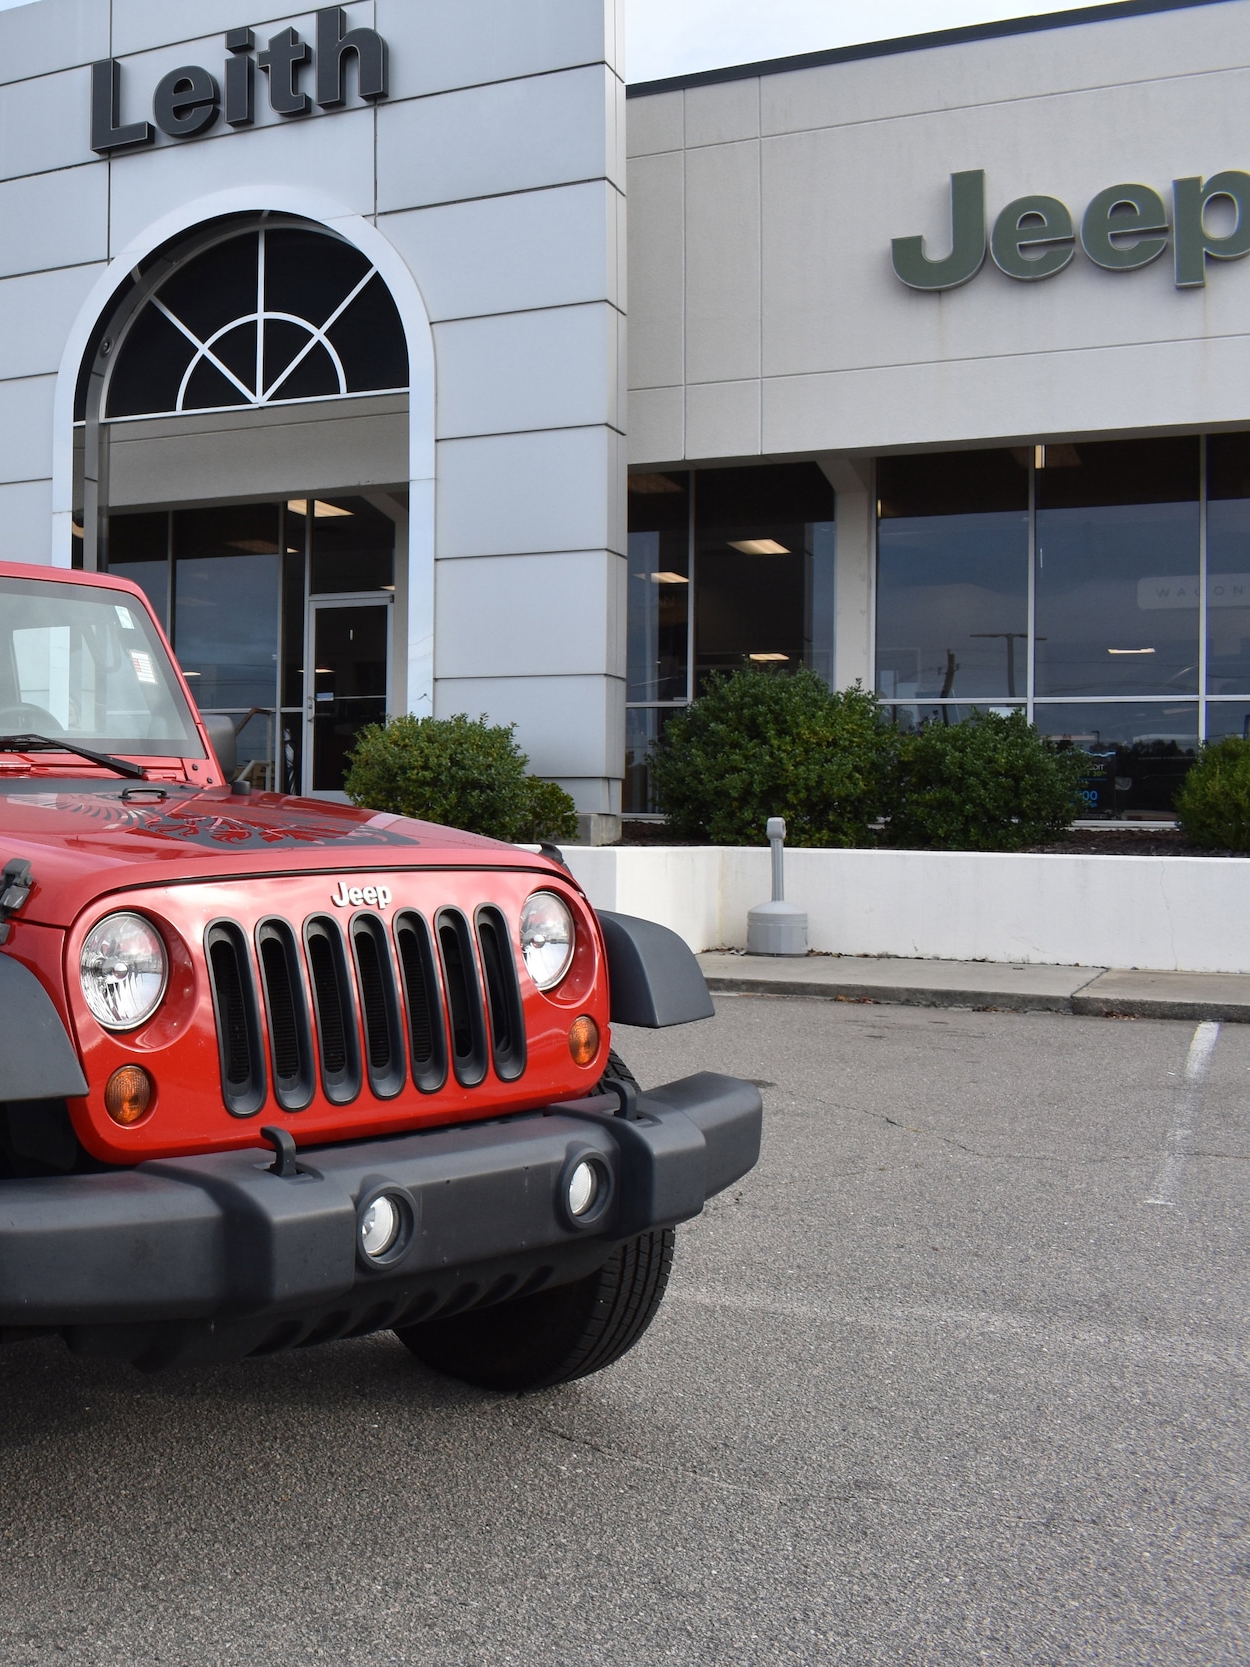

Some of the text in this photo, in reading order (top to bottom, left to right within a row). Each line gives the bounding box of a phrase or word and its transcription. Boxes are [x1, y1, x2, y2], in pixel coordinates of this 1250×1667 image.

[90, 6, 389, 154] Leith
[890, 168, 1250, 290] Jeep
[331, 881, 392, 910] Jeep
